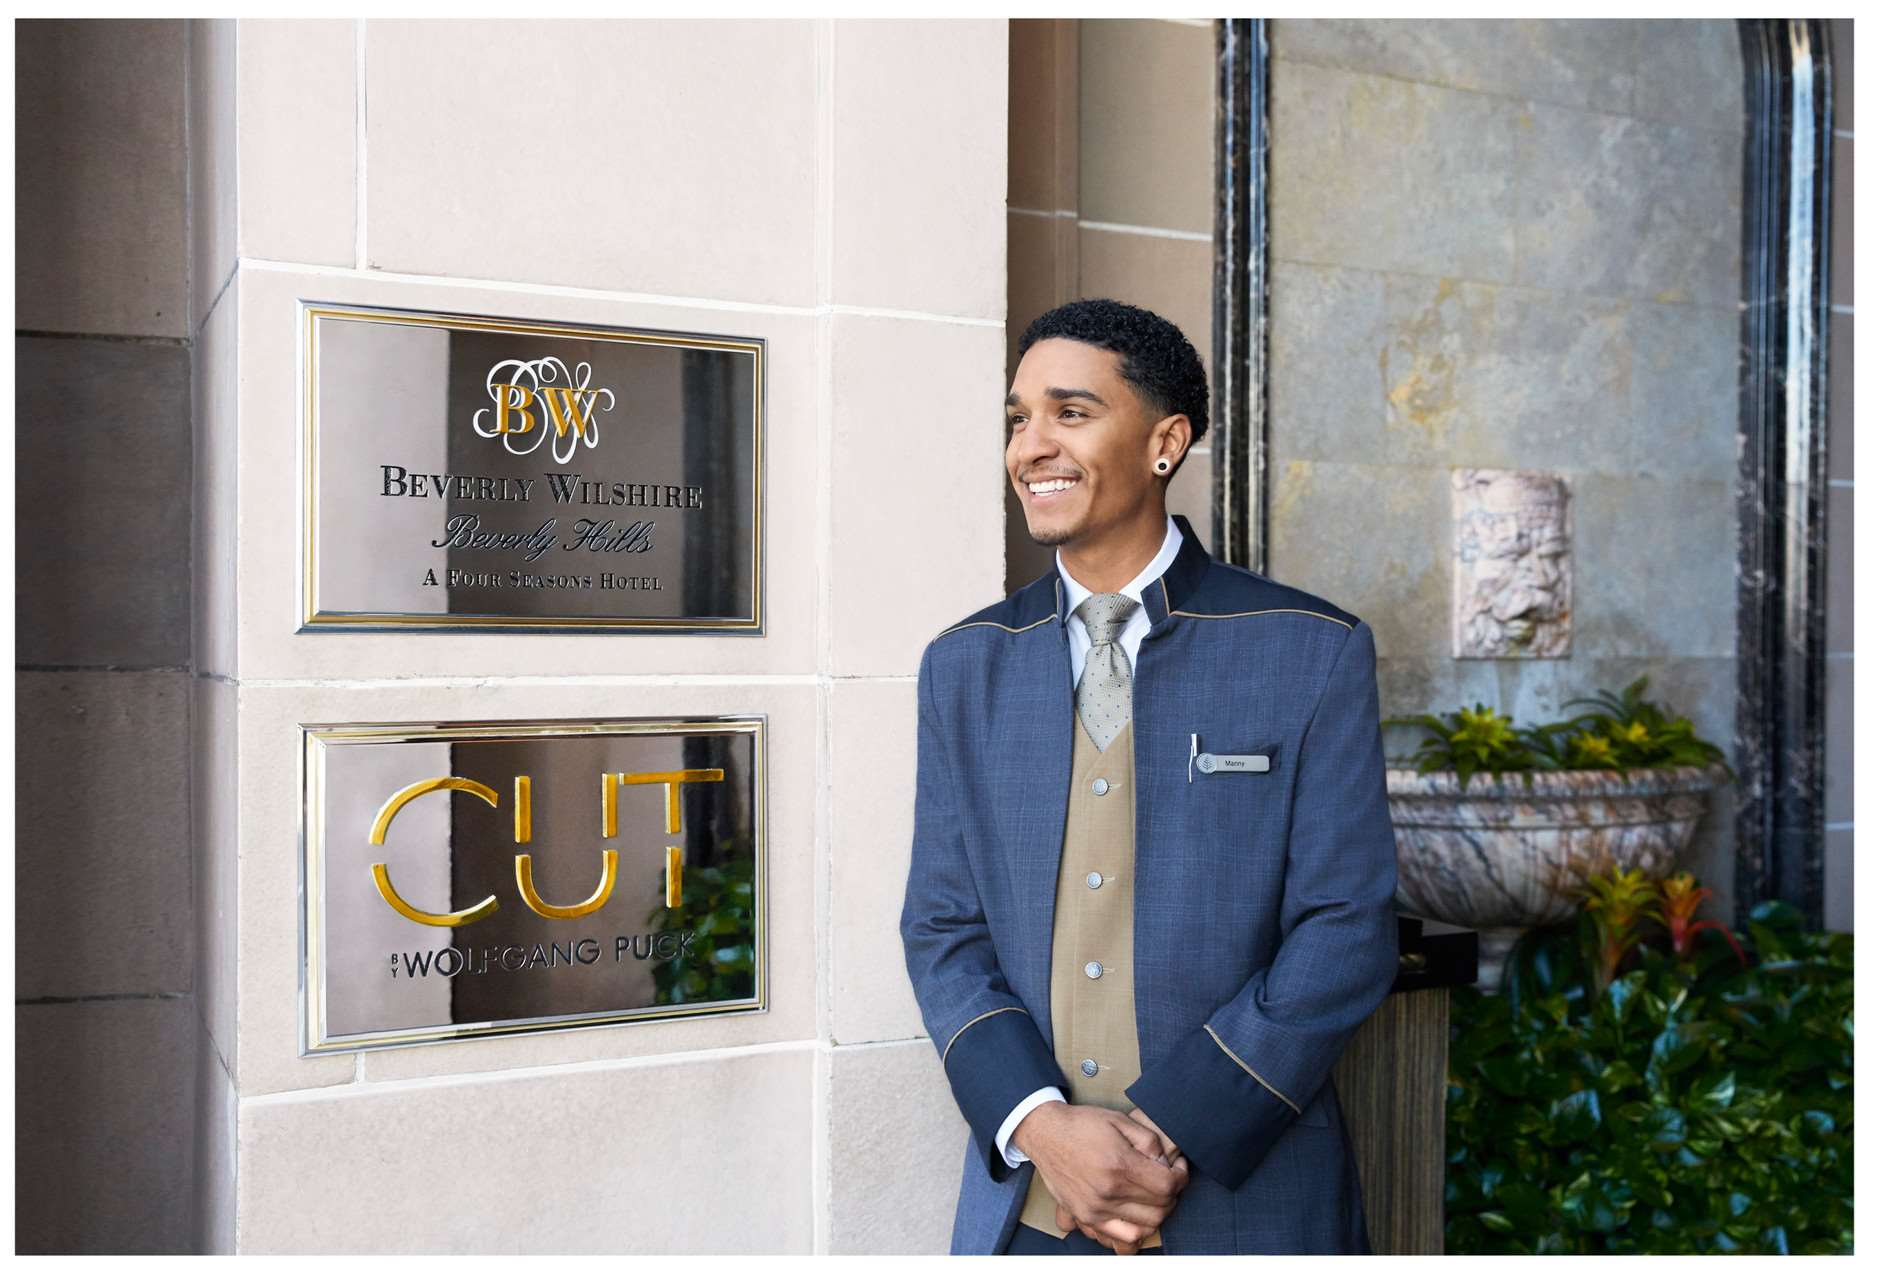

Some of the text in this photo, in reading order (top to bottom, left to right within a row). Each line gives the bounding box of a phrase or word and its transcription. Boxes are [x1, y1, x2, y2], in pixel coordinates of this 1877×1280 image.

[379, 465, 703, 510] BEVERLY WILSHIRE
[431, 514, 655, 562] Beverly Hills
[422, 568, 664, 592] A FOUR SEASONS HOTEL
[1225, 760, 1245, 768] Manny
[368, 768, 724, 927] CUT
[403, 938, 602, 978] WOLFGANG
[615, 931, 695, 963] PUCK
